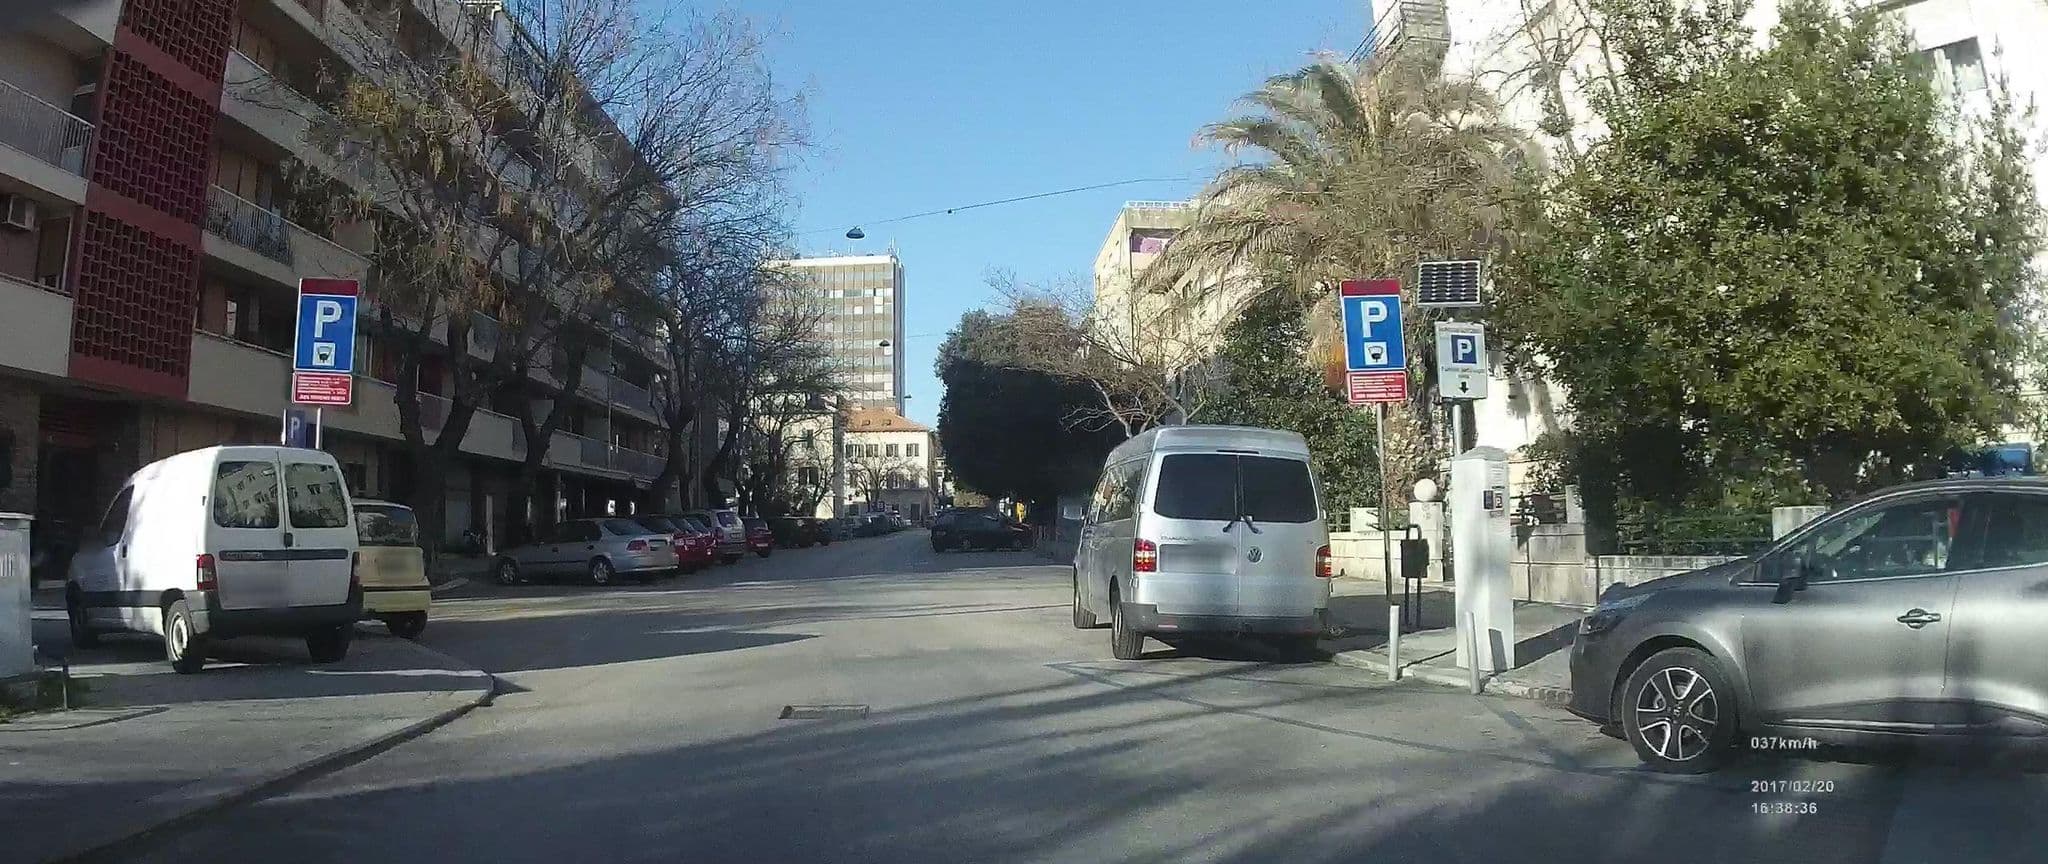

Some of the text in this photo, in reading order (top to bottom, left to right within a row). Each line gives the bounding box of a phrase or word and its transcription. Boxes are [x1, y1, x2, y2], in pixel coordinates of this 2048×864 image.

[314, 300, 342, 338] P
[1360, 300, 1387, 338] P
[1457, 339, 1472, 360] P
[291, 416, 300, 438] P
